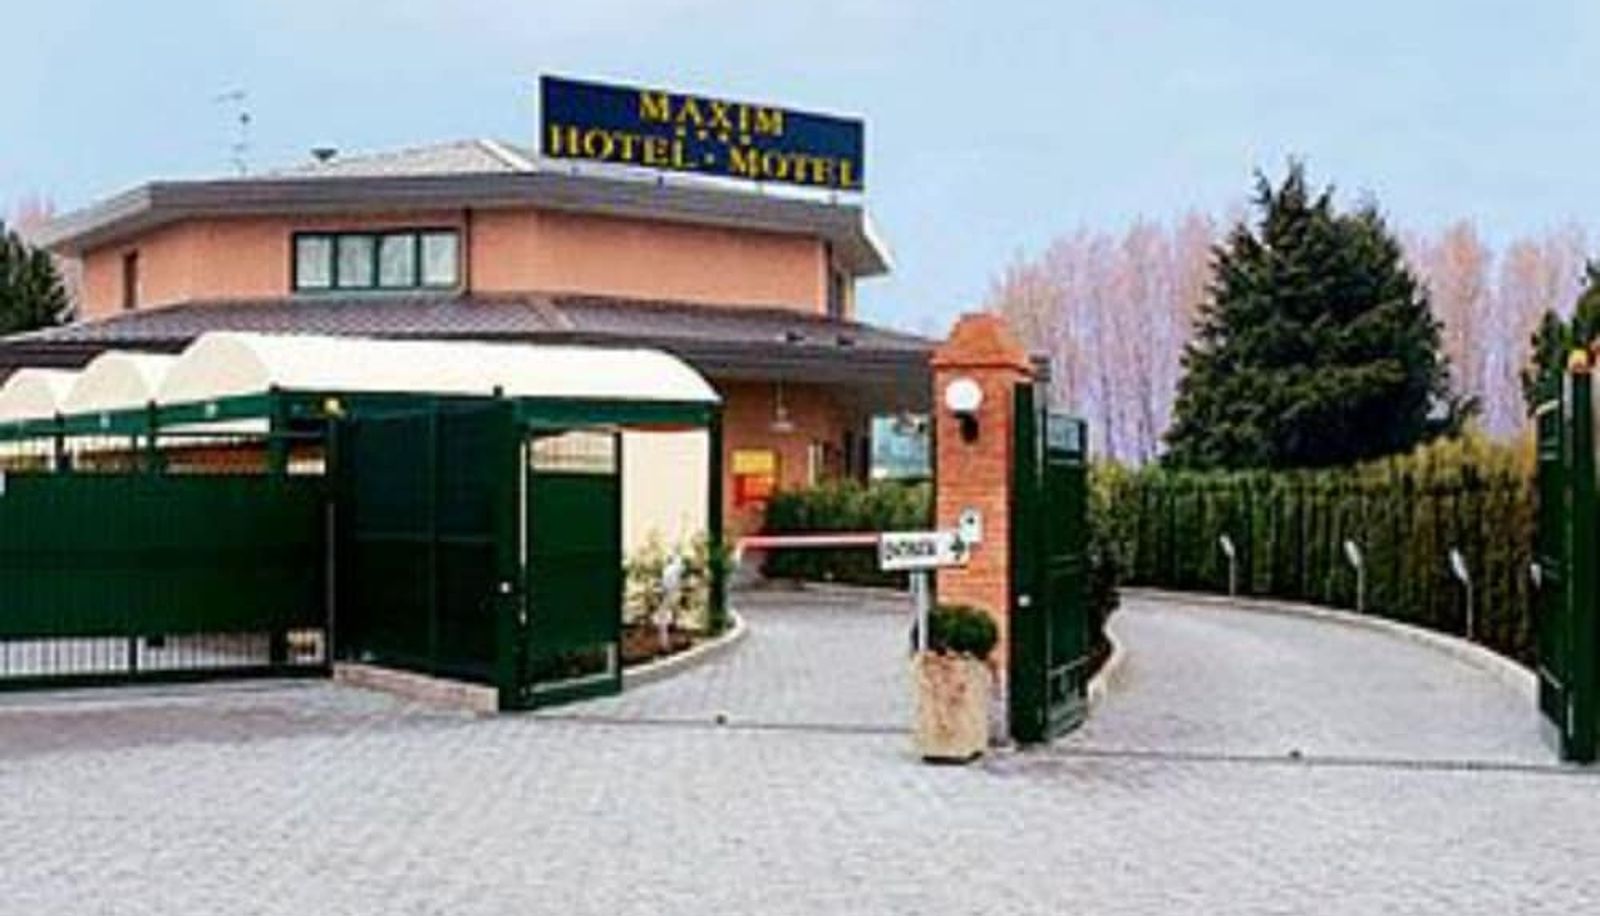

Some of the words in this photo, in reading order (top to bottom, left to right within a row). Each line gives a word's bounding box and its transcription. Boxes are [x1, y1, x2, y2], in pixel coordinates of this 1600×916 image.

[639, 91, 784, 136] MAXIM
[550, 124, 696, 168] HOTEL
[729, 147, 858, 187] MOTEL
